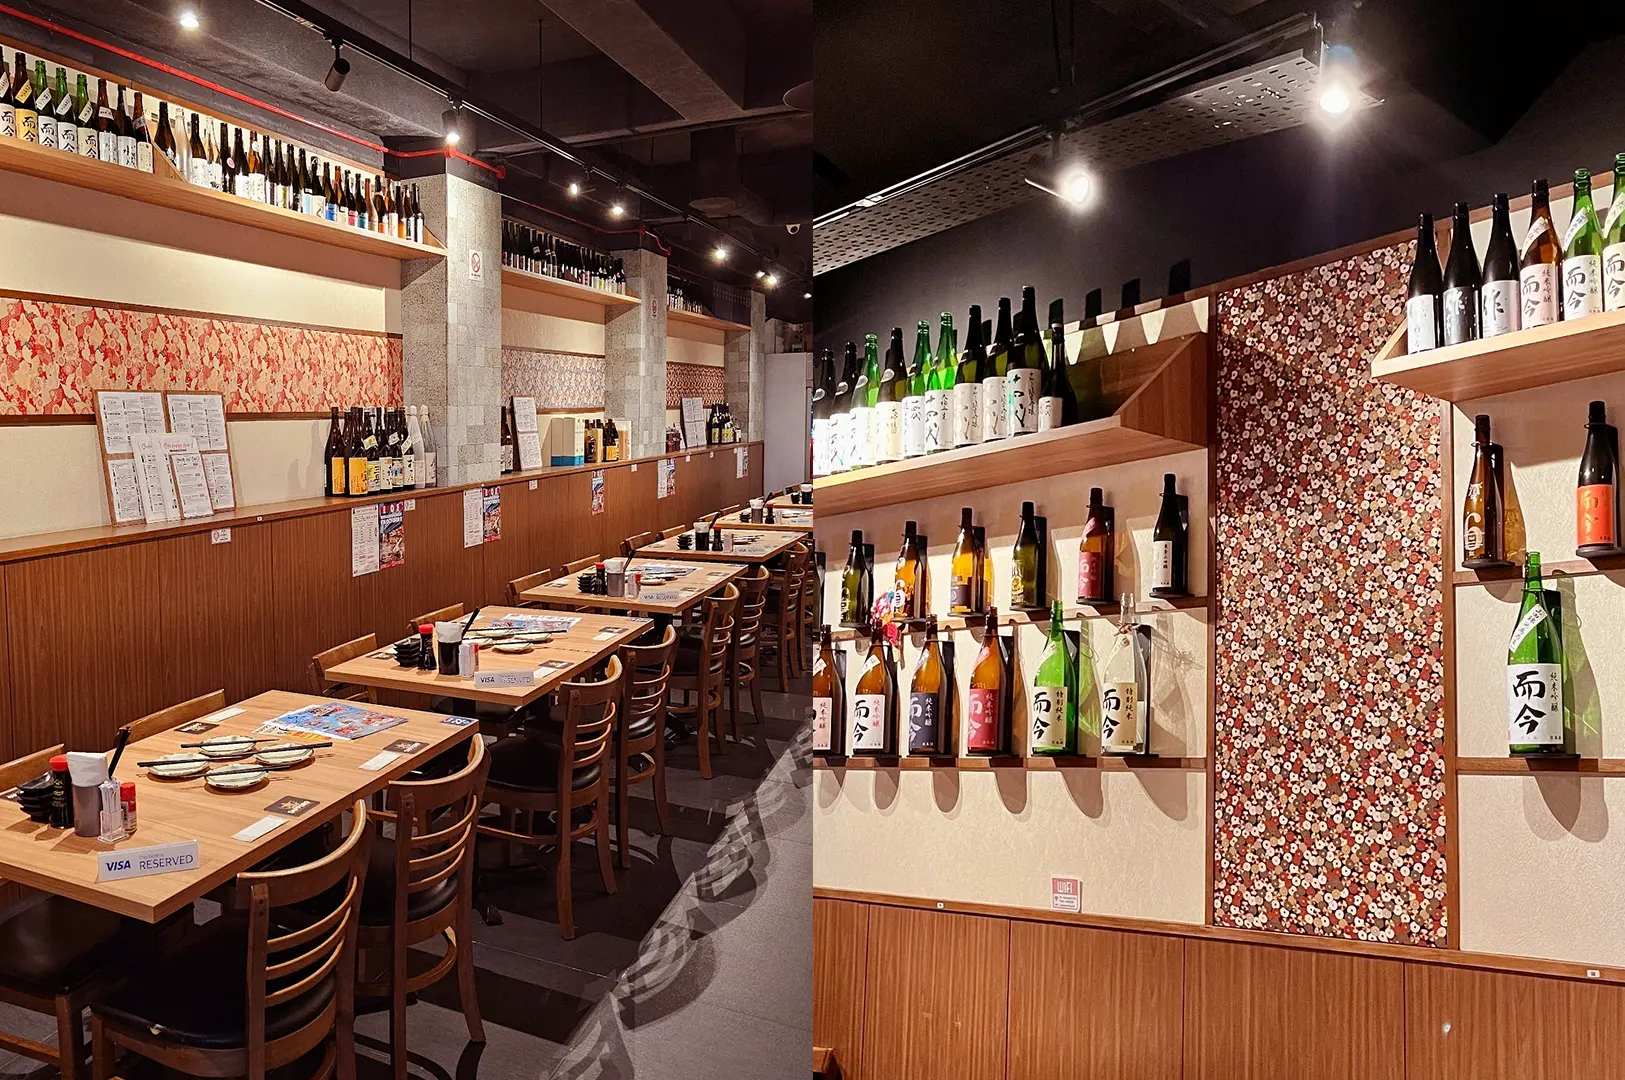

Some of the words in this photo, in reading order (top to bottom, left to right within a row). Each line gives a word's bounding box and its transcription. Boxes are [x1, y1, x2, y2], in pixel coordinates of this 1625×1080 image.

[22, 116, 36, 143] 而今
[1522, 275, 1540, 317] 而今
[1566, 266, 1586, 309] 而今
[854, 699, 870, 743] 而今
[1033, 691, 1052, 740] 而今
[1102, 688, 1121, 740] 而今
[1513, 670, 1547, 735] 而今
[105, 860, 131, 872] VISA
[139, 854, 194, 871] RESERVED
